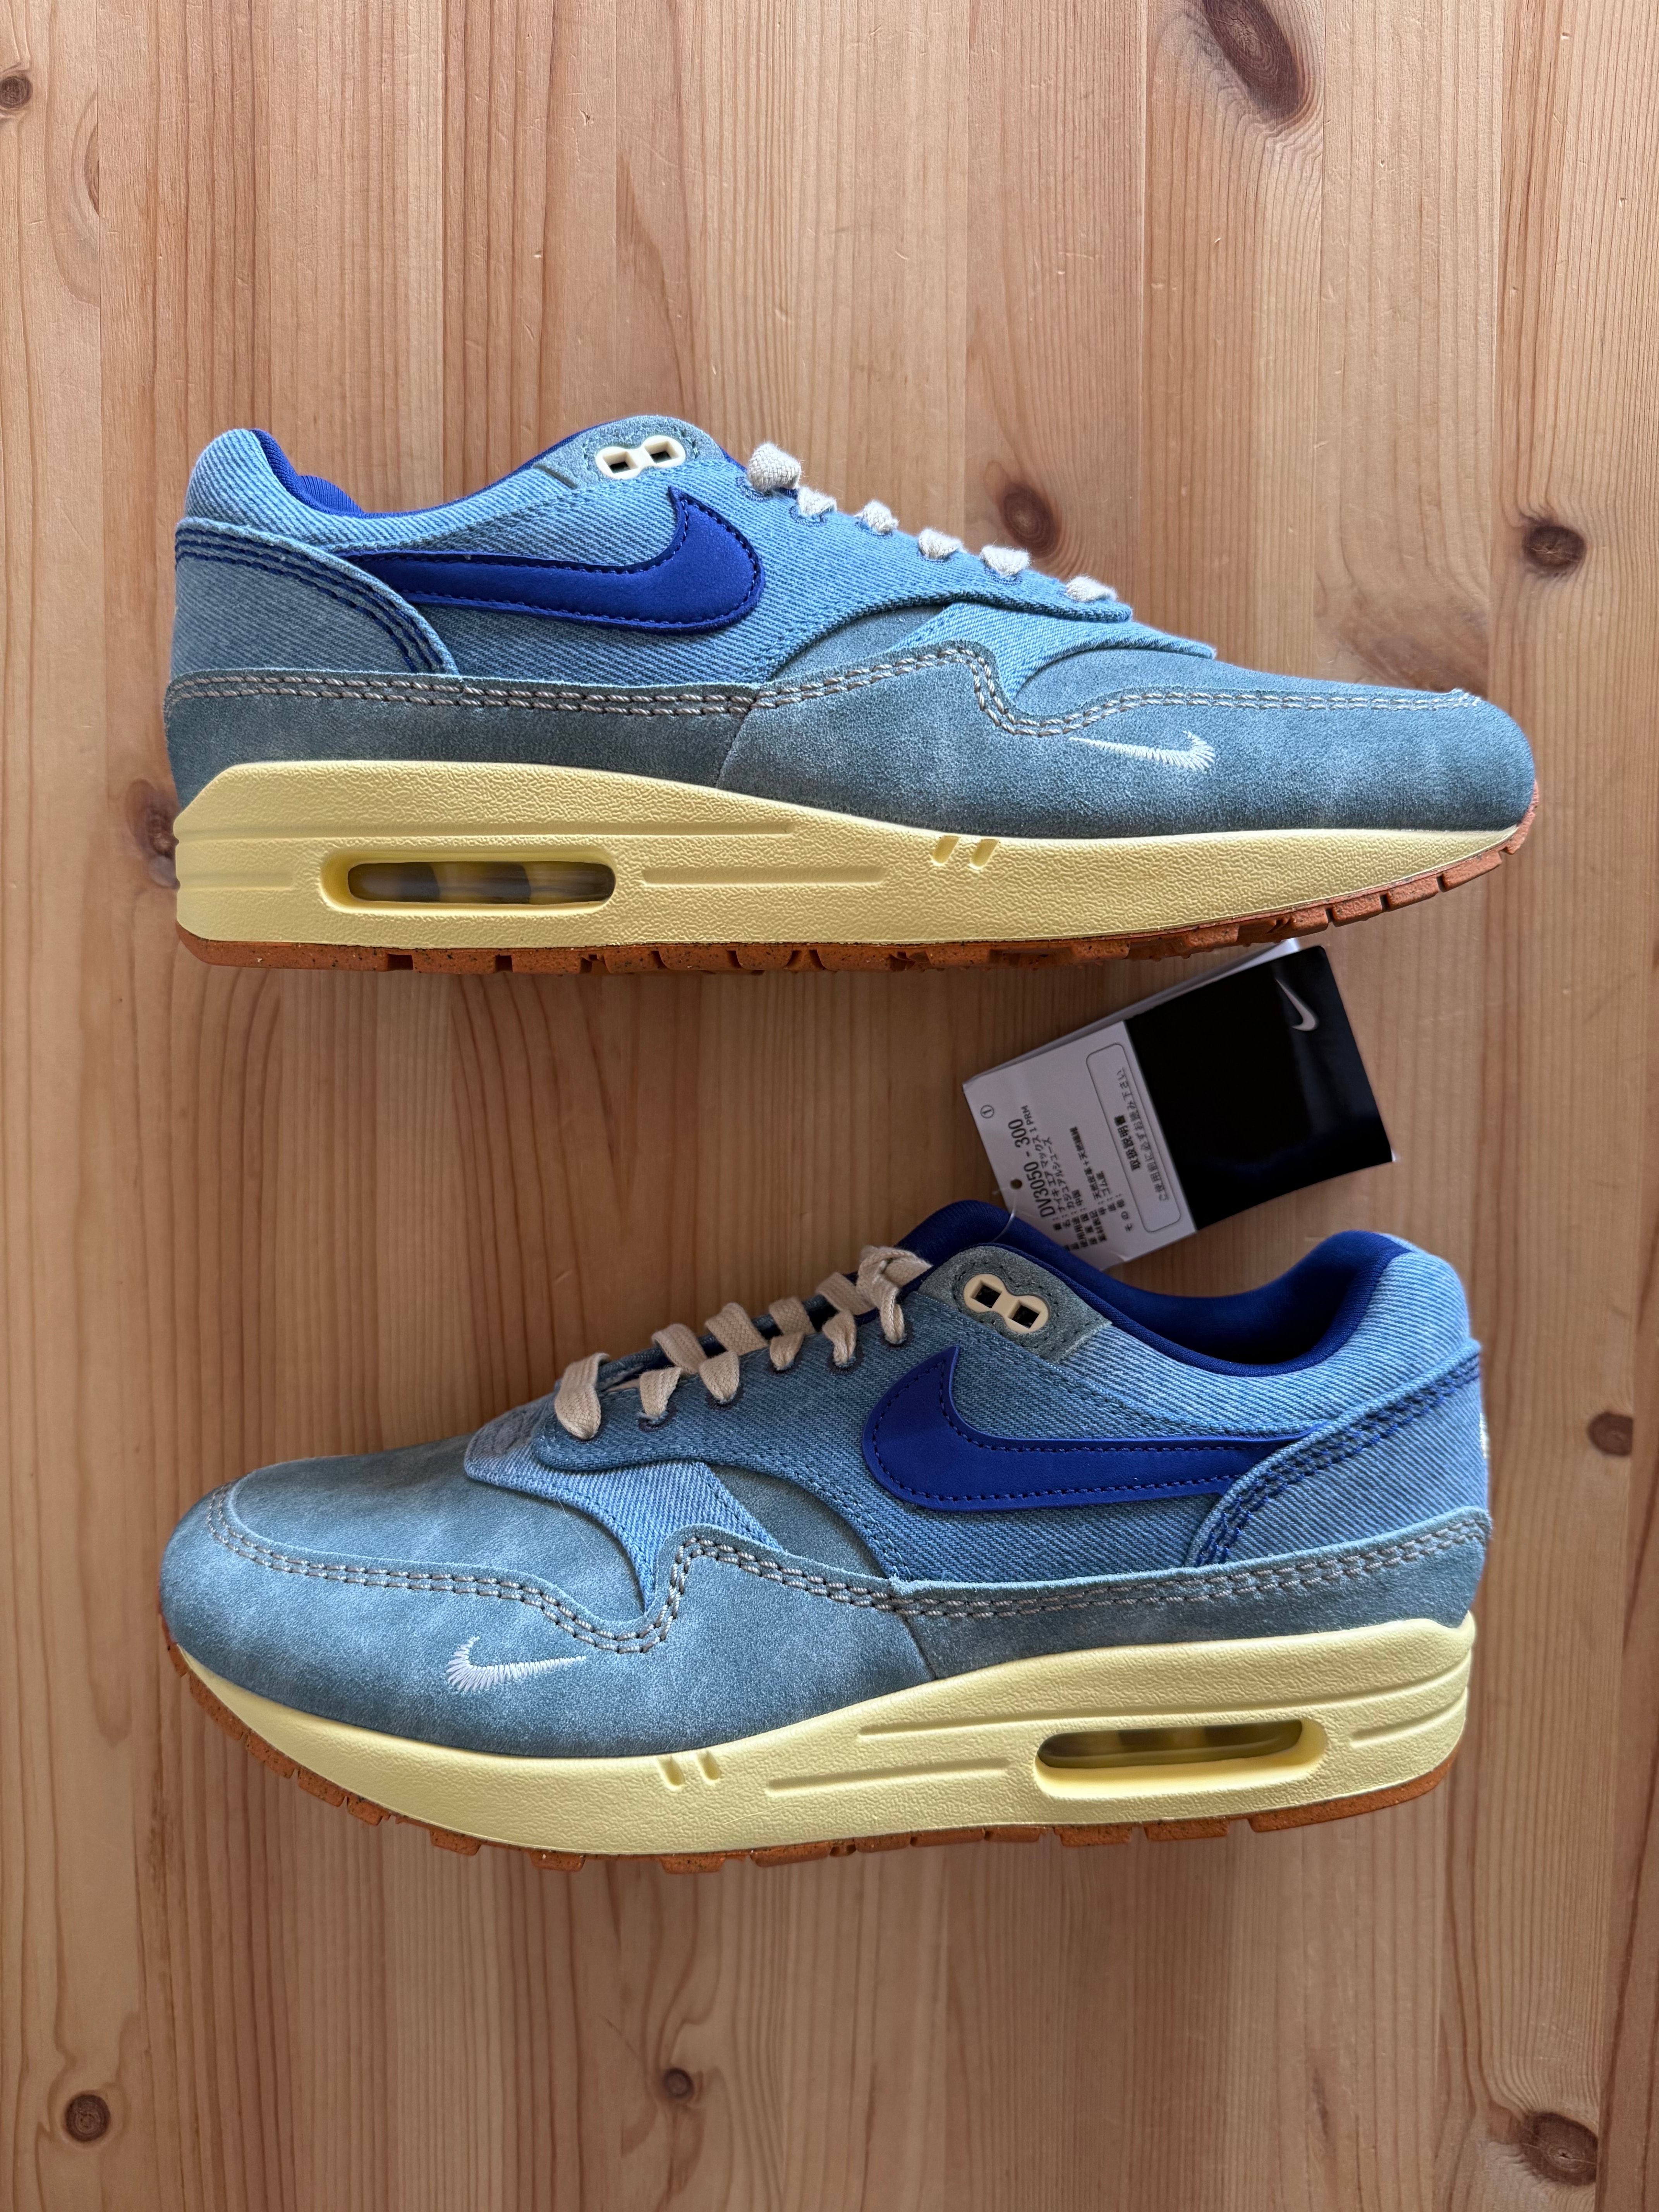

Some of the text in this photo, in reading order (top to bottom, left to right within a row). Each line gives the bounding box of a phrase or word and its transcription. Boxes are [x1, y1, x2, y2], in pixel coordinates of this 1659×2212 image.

[1021, 1105, 1033, 1125] PRM
[1008, 1119, 1030, 1147] 300
[1114, 1115, 1140, 1171] 取扱説明書
[1117, 1069, 1168, 1201] ご使用前に必ずお読み下さい
[1032, 1135, 1048, 1168] マックス
[1042, 1137, 1075, 1209] カジュアルシューズ
[1044, 1171, 1056, 1187] エア
[1024, 1162, 1056, 1217] DV3050
[1051, 1188, 1065, 1212] ナイキ
[1072, 1189, 1083, 1206] 中国
